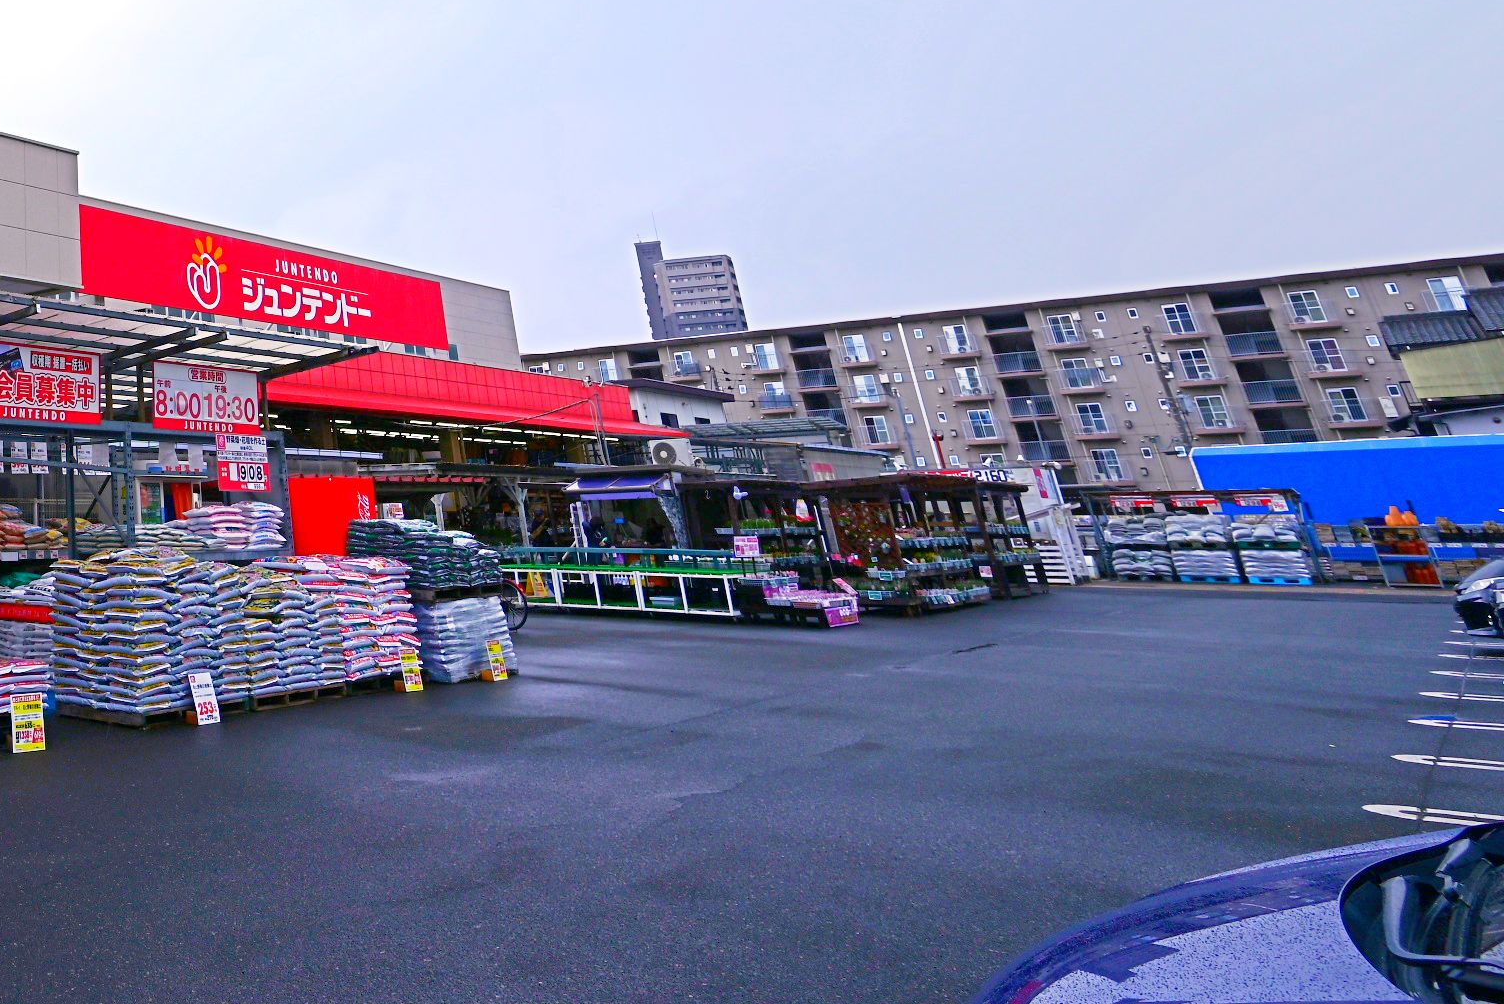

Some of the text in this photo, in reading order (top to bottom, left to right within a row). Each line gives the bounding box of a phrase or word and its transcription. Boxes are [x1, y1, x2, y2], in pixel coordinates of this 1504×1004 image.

[275, 259, 338, 284] JUNTENDO
[241, 276, 371, 327] ジュンテンドー
[190, 368, 226, 383] 営業時間
[156, 379, 171, 389] 午前
[214, 384, 227, 394] 午後
[3, 406, 67, 421] JUNTENDO
[184, 421, 234, 433] JUNTENDO
[198, 701, 214, 715] 253
